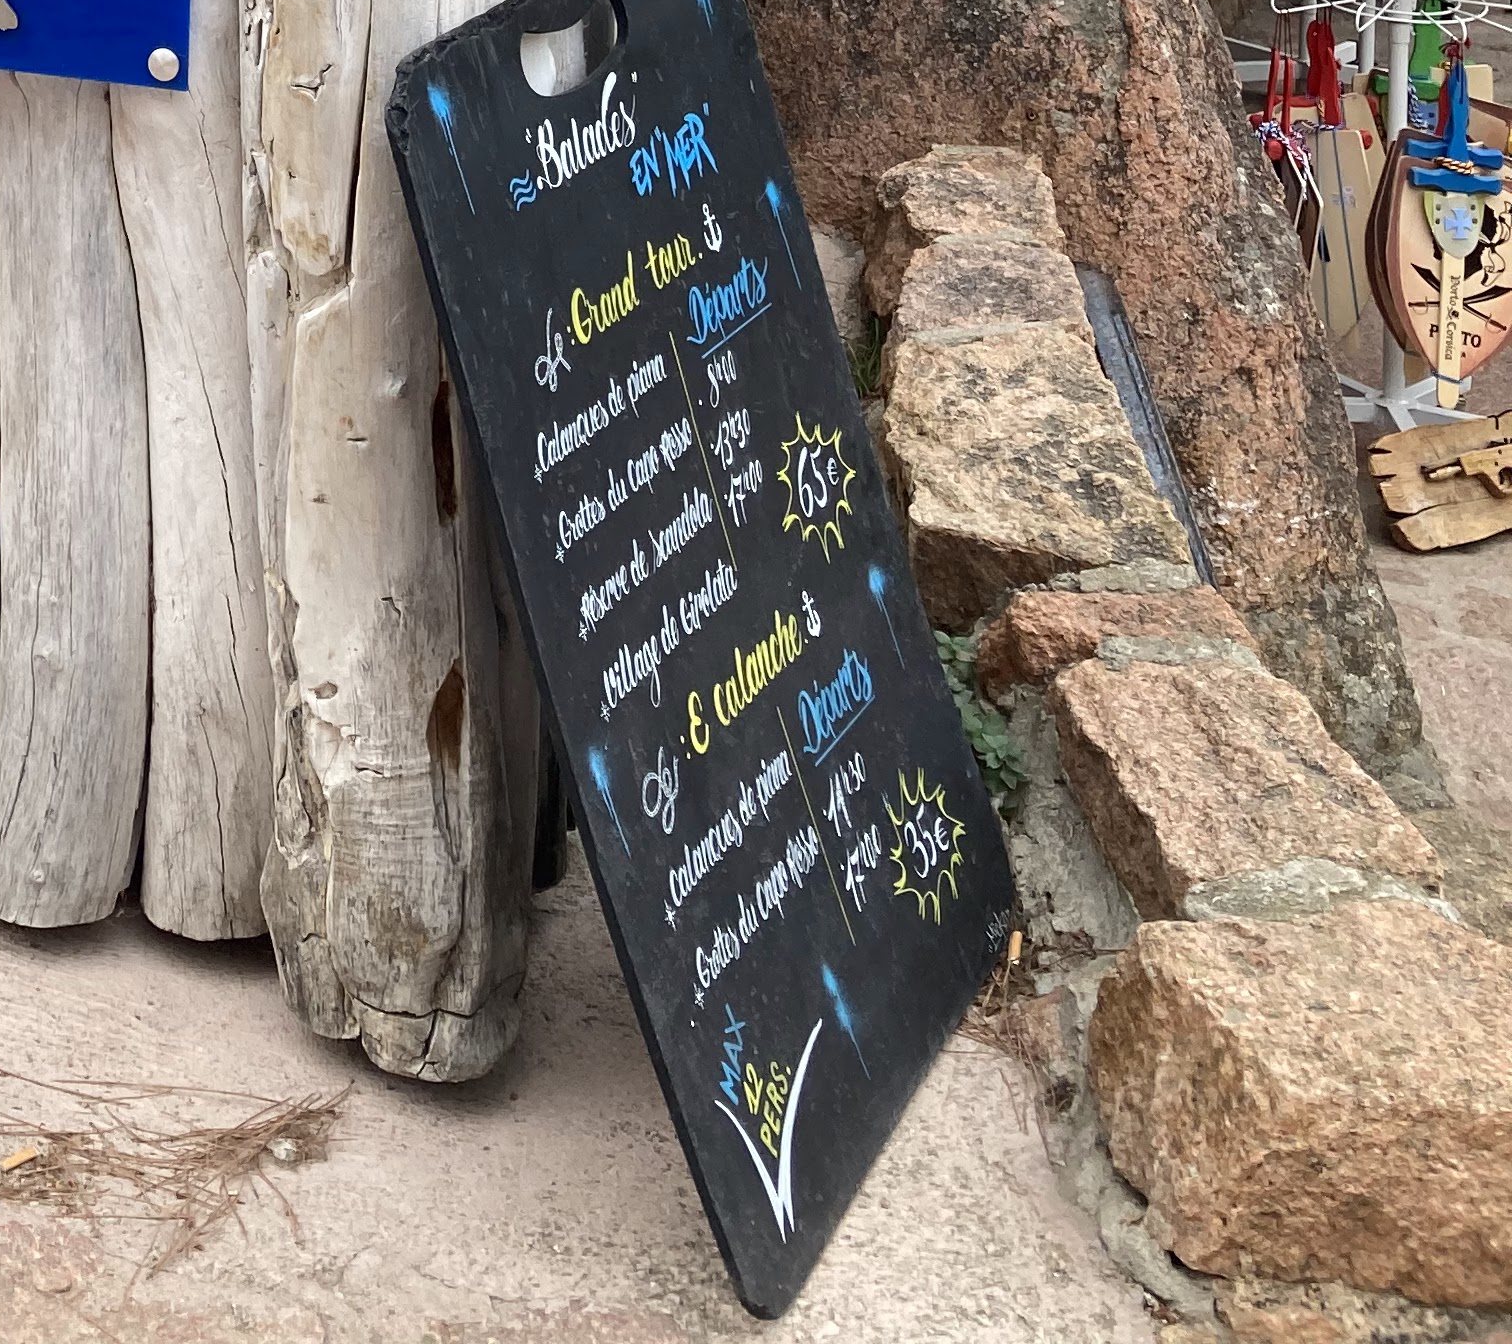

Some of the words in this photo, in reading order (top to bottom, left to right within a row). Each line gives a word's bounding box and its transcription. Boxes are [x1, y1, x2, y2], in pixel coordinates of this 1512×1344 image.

[629, 134, 660, 197] EN
[687, 256, 768, 344] Départs
[1429, 323, 1482, 348] PTO
[608, 377, 626, 417] de
[707, 349, 737, 409] 8h00
[559, 494, 606, 550] Grottes
[607, 468, 628, 512] du
[631, 539, 649, 587] de
[661, 605, 679, 655] de
[797, 648, 874, 754] Départs
[738, 780, 757, 826] de
[695, 924, 740, 989] Grottes
[737, 893, 759, 944] du
[719, 1003, 746, 1106] MAX
[743, 1062, 763, 1116] 12
